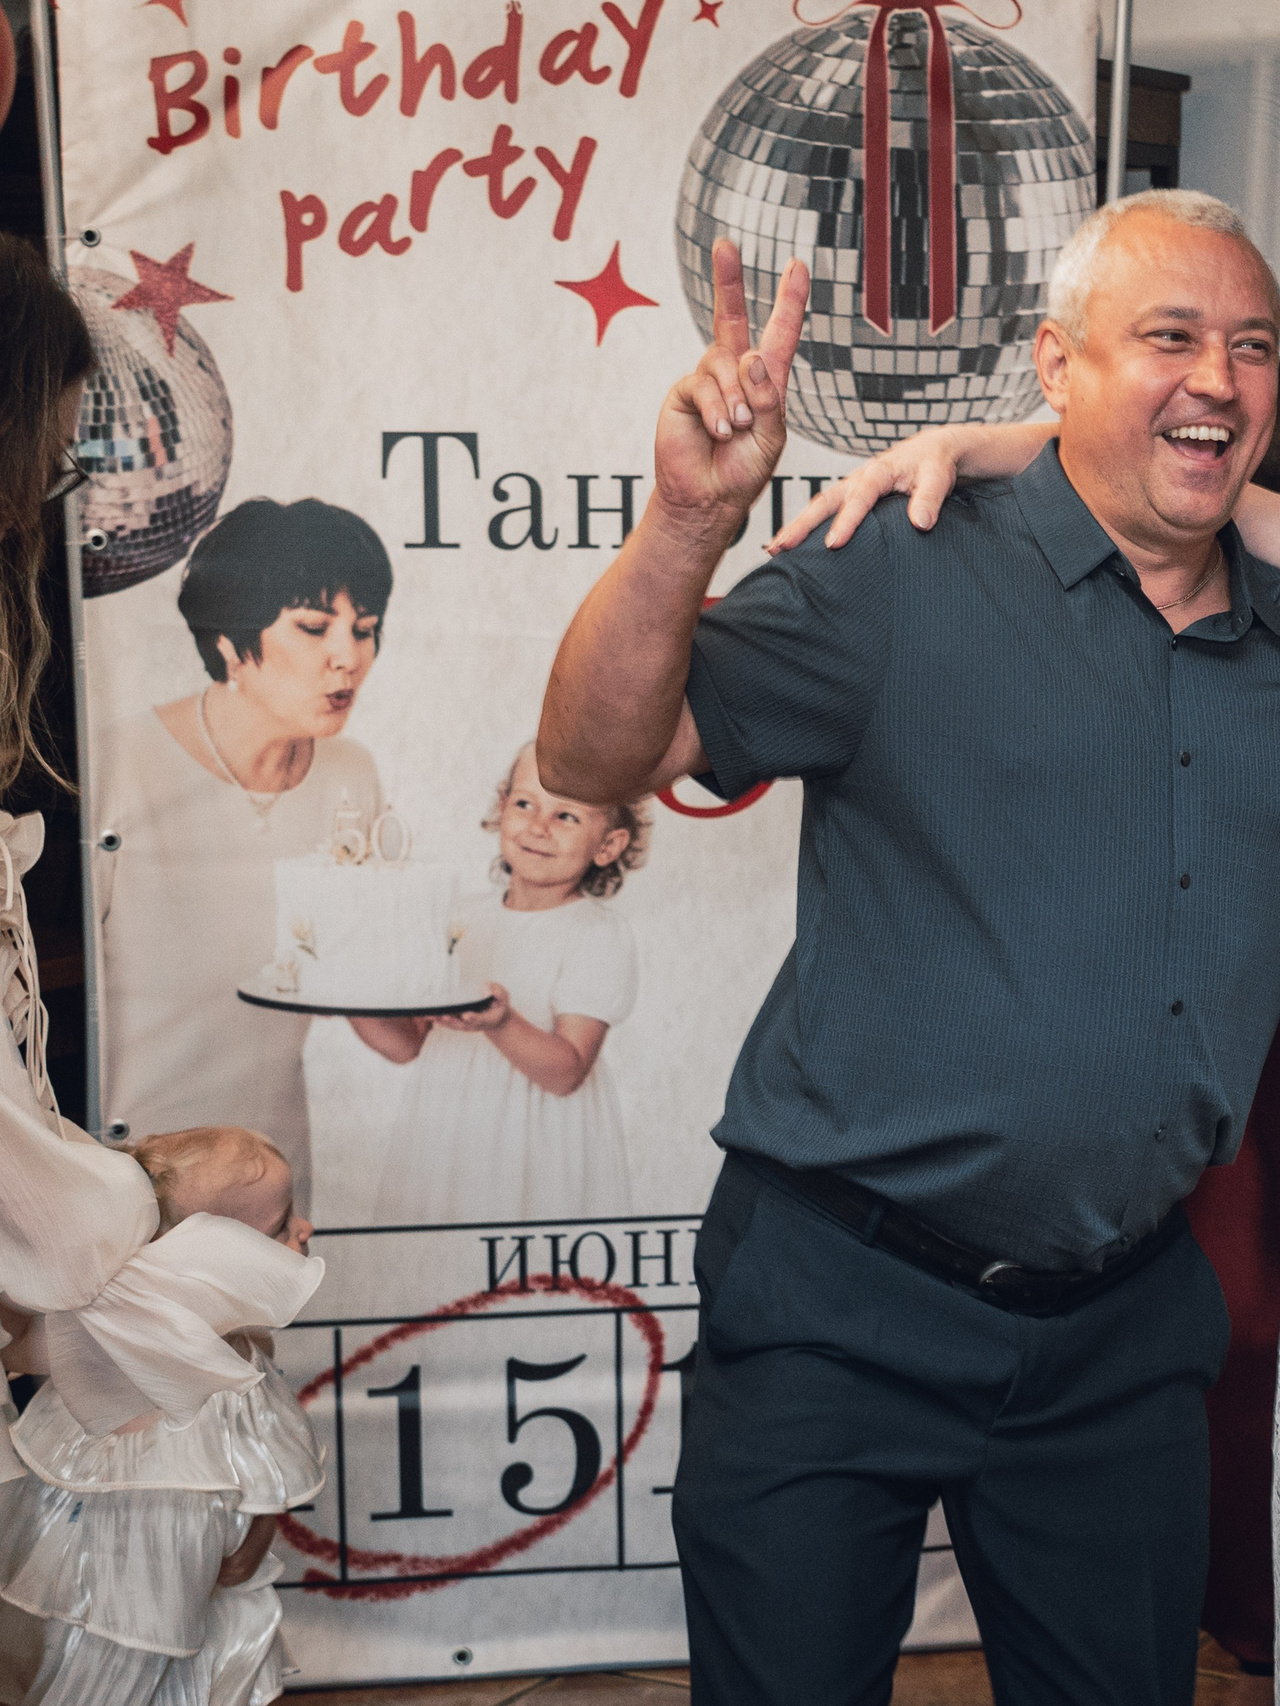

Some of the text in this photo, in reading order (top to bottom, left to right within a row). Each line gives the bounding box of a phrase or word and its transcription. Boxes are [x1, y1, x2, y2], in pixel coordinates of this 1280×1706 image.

[146, 0, 665, 154] Birthday
[280, 124, 598, 292] party
[382, 432, 848, 550] Тан
[479, 1229, 701, 1295] ИЮН
[366, 1354, 602, 1522] 15
